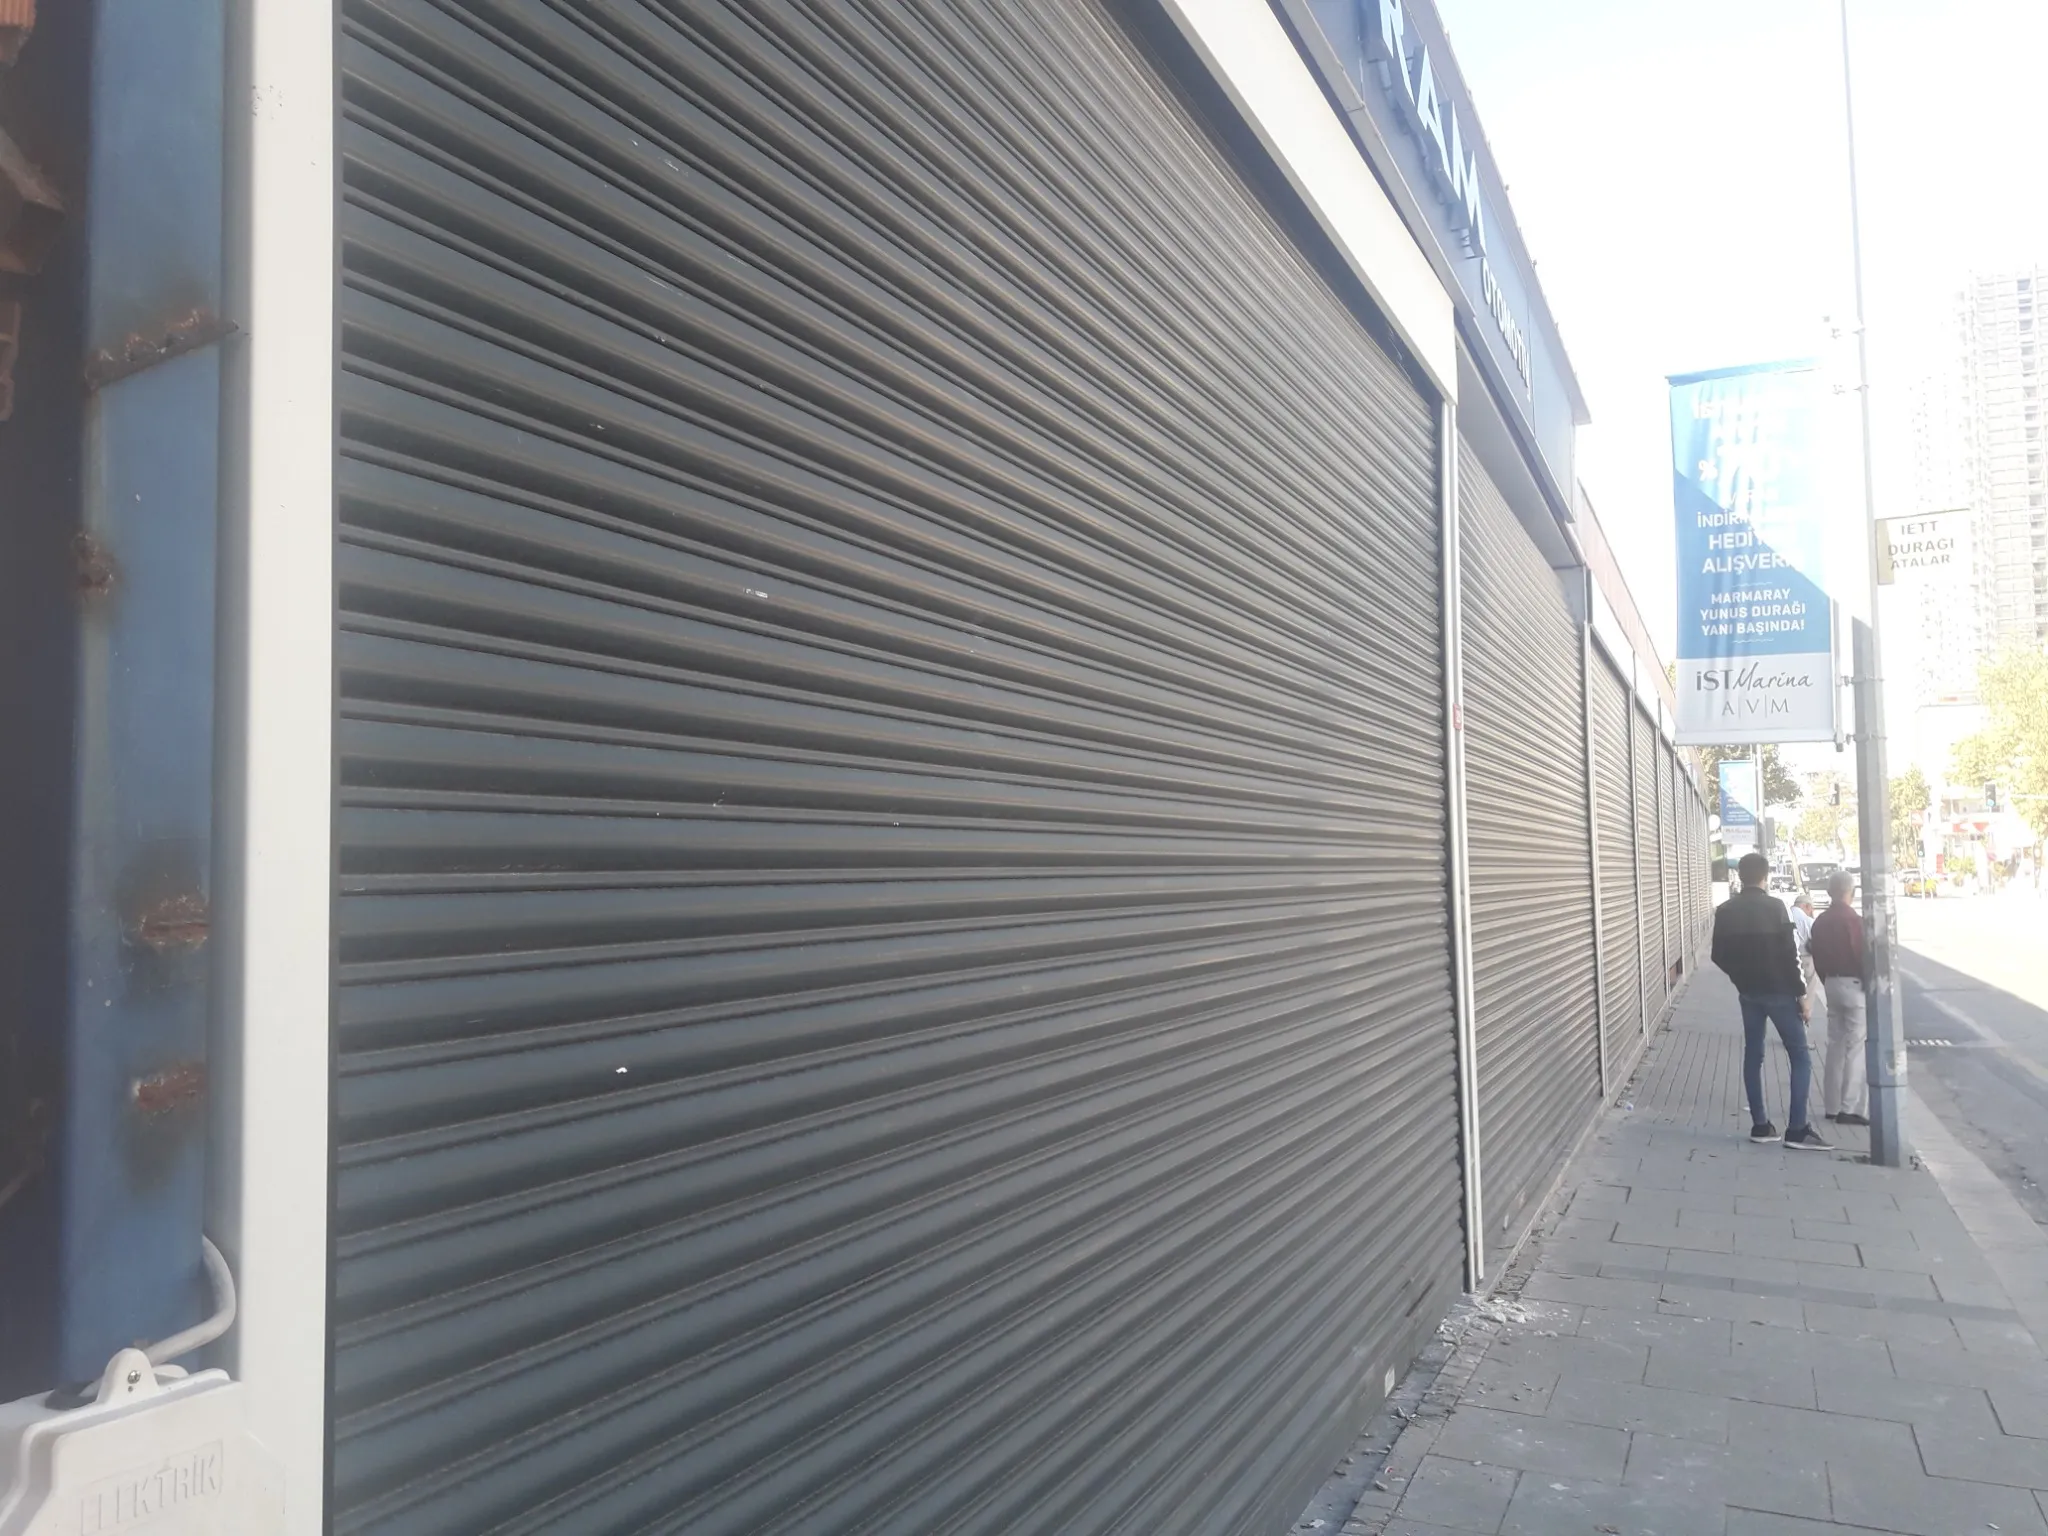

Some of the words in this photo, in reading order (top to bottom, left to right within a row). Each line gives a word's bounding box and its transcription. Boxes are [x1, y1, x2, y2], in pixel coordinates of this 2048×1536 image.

[1890, 554, 1950, 571] ATALAR
[1711, 588, 1791, 604] MARMARAY
[1700, 606, 1748, 620] YUNUS
[1751, 601, 1806, 617] DURAĞI
[1701, 624, 1733, 636] YANI
[1736, 619, 1805, 636] BAŞINDA!
